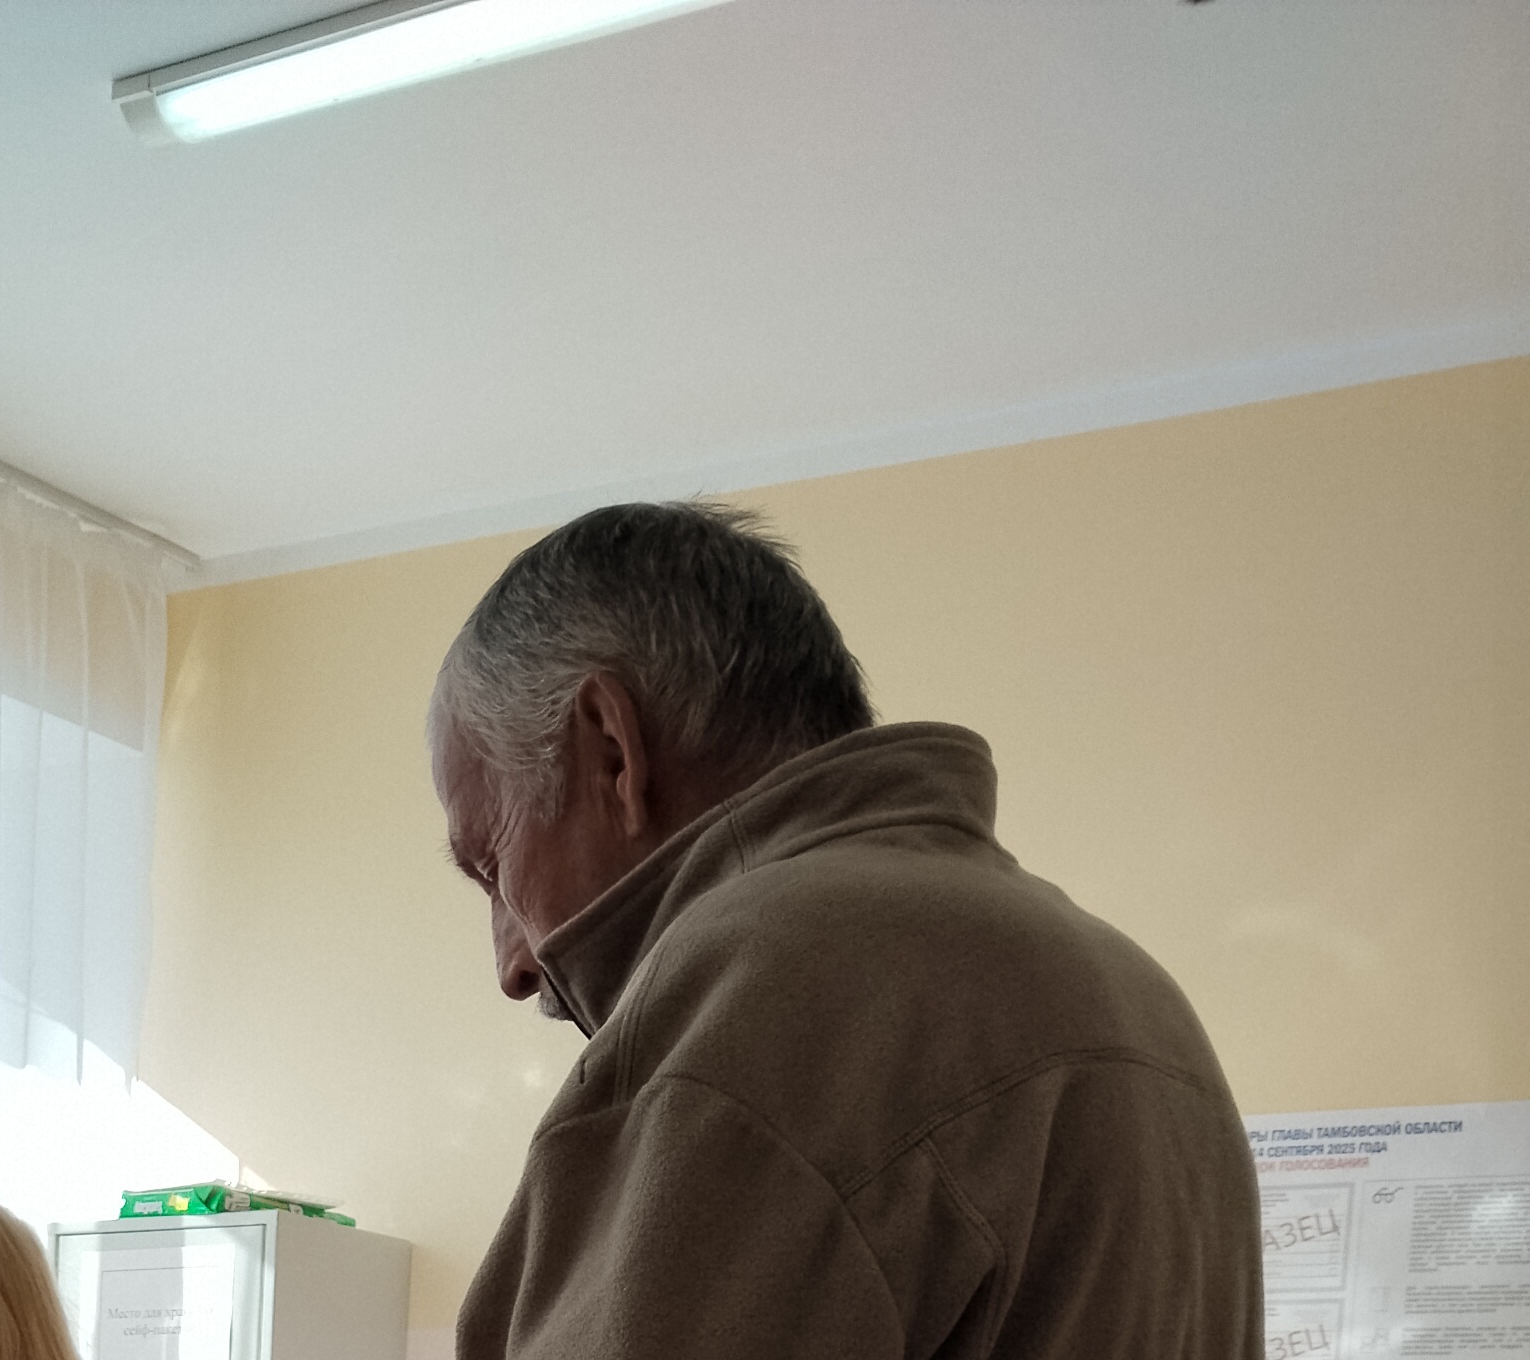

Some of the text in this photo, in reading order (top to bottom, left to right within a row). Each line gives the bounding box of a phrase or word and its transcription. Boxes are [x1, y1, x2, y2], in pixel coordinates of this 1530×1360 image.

[1271, 1128, 1314, 1141] ГЛАВЫ
[1316, 1121, 1401, 1139] ТАМБОВСКОЙ
[1405, 1120, 1463, 1134] ОБЛАСТИ
[1267, 1144, 1324, 1157] СЕНТЯБРЯ
[1327, 1143, 1356, 1155] 2025
[1358, 1141, 1388, 1155] ГОДА
